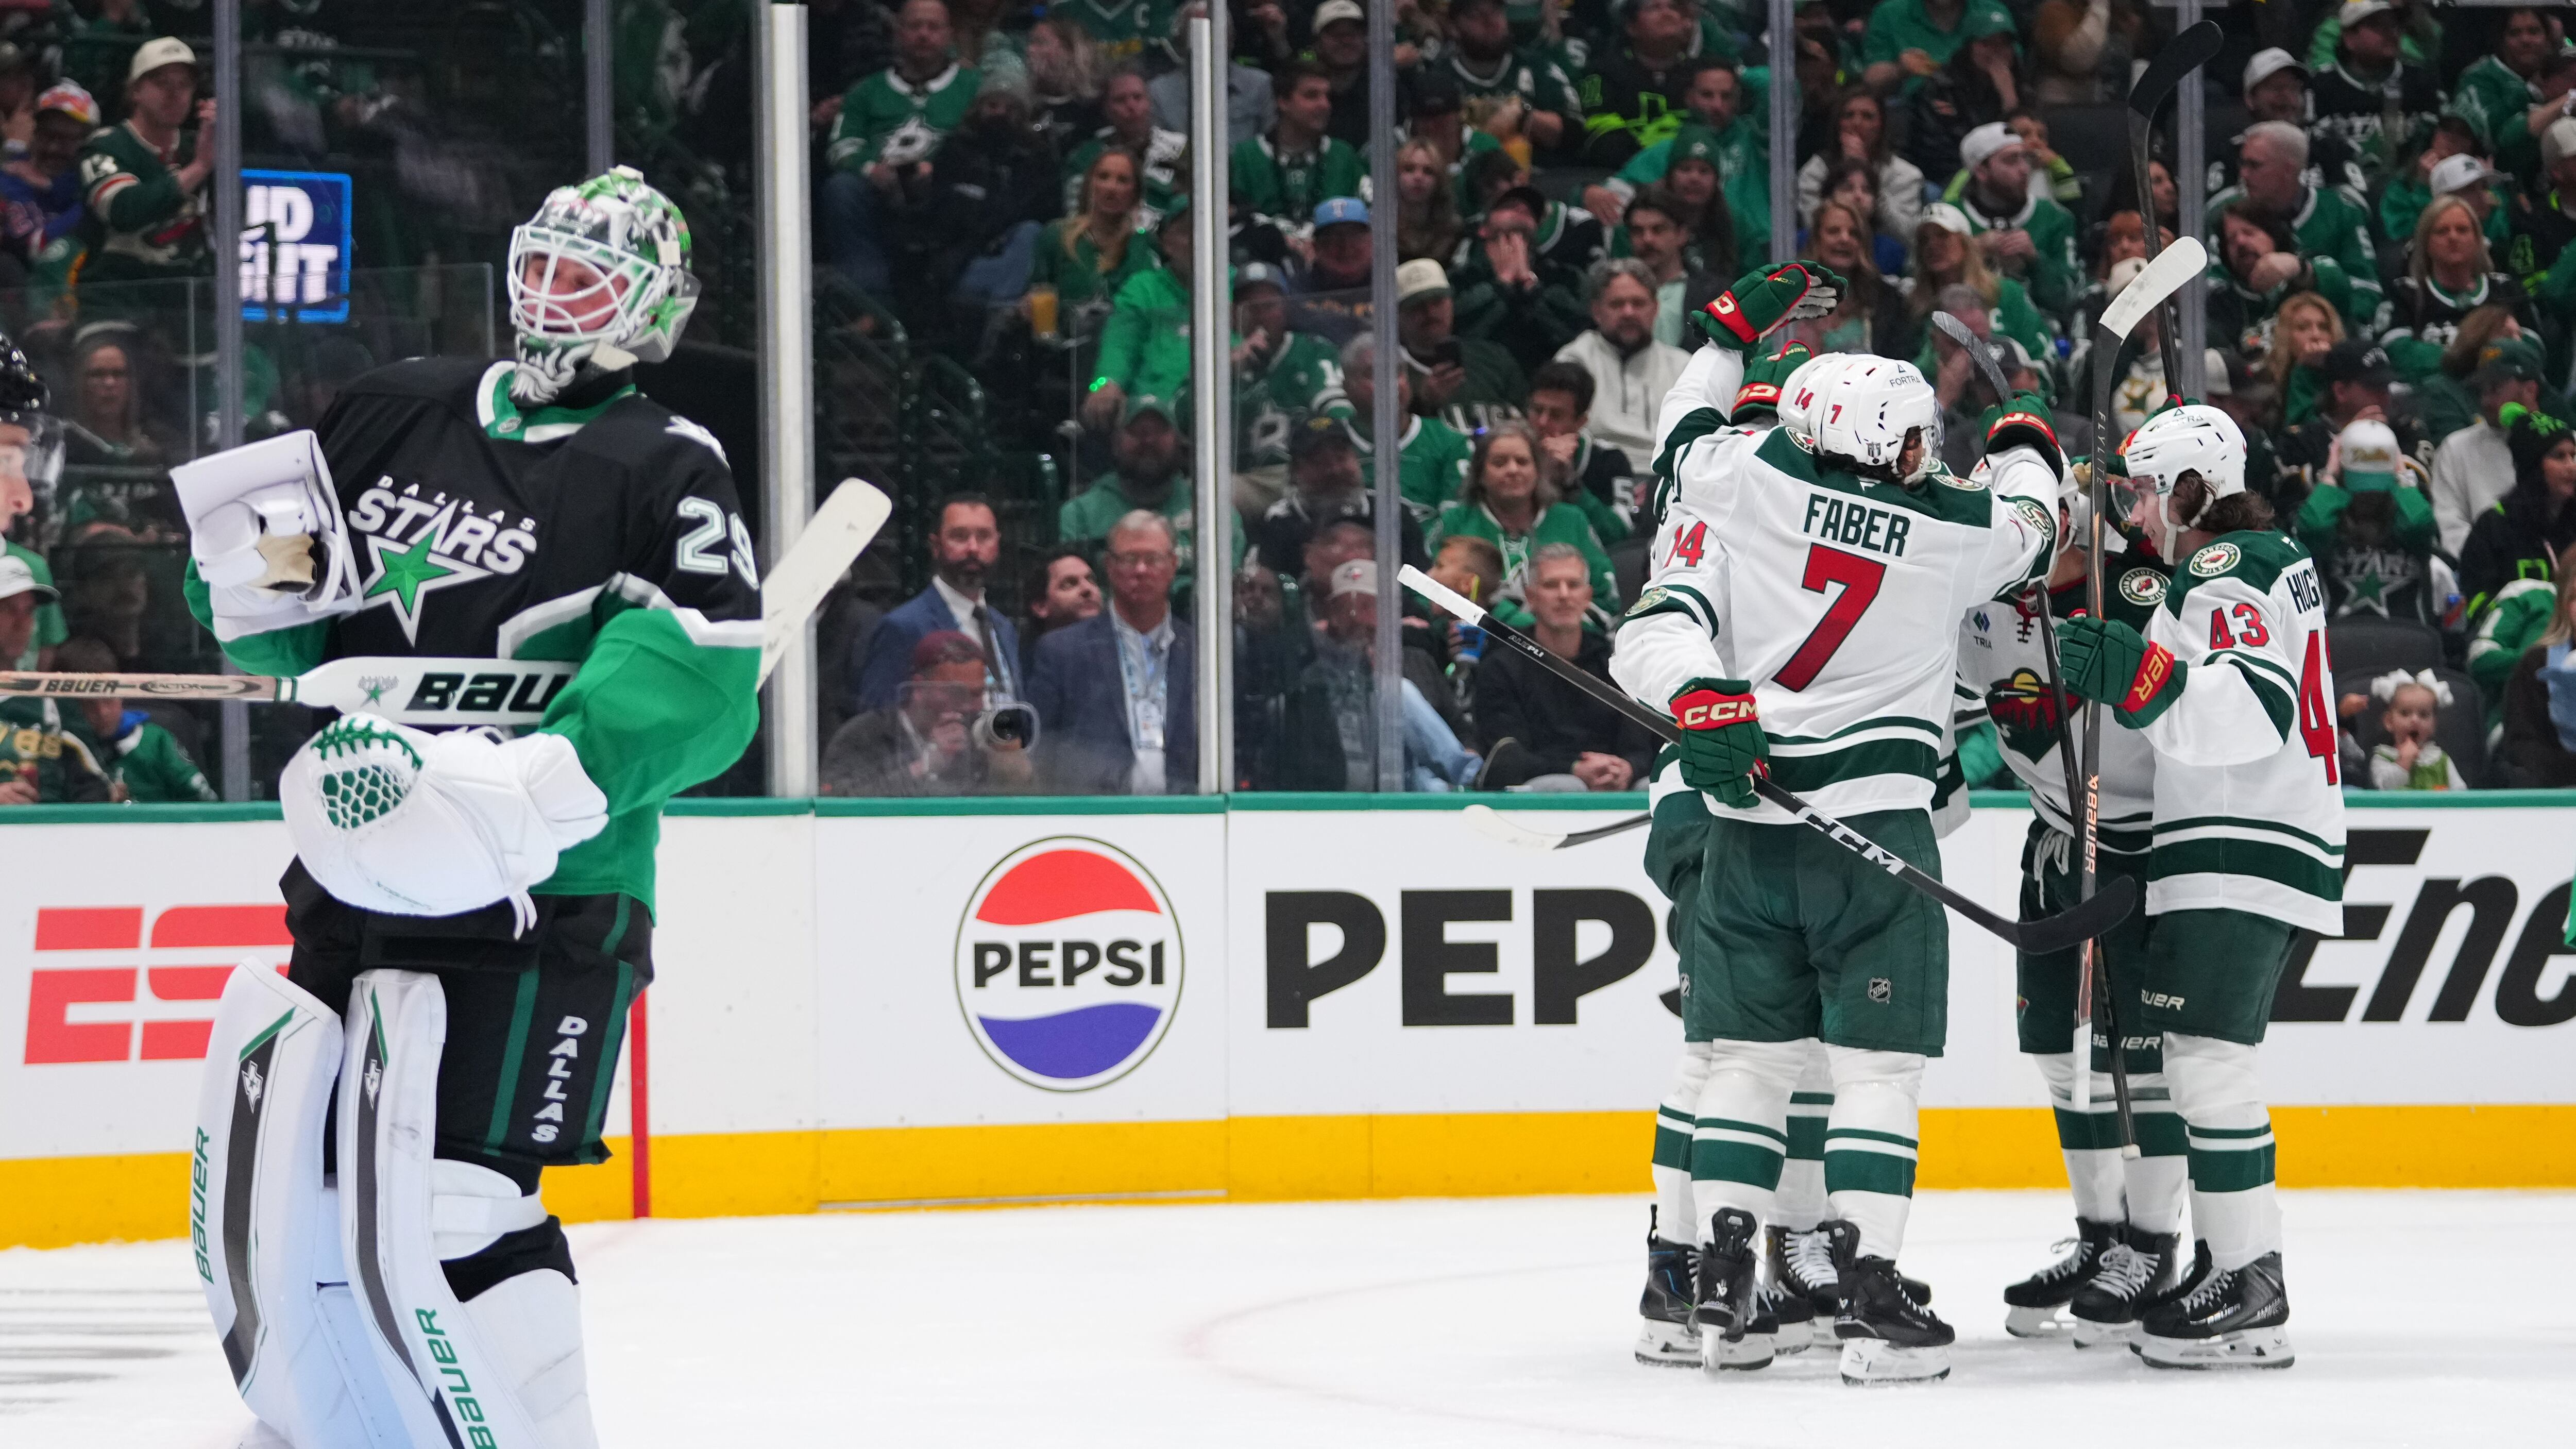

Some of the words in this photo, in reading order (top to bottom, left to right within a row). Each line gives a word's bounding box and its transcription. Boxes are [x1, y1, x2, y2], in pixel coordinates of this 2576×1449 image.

[1794, 387, 1814, 410] 14
[1890, 376, 1921, 387] FORTRA
[1831, 404, 1842, 424] 7
[2096, 410, 2107, 486] FLYLITE
[348, 487, 537, 575] STARS
[377, 475, 536, 532] DALLAS
[1804, 493, 1911, 557] FABER
[676, 495, 760, 591] 29
[1663, 520, 1708, 567] 14
[2200, 565, 2224, 574] WILD
[1770, 542, 1888, 693] 7
[1973, 635, 1993, 650] TRIA
[2210, 603, 2270, 650] 43
[44, 679, 118, 694] BAUER
[404, 672, 572, 713] BAU
[2134, 643, 2172, 701] UER
[1684, 701, 1759, 727] CCM
[2299, 626, 2336, 786] 4
[1796, 806, 1906, 876] CCM
[2086, 791, 2098, 874] BAUER
[24, 903, 297, 1064] ES
[974, 939, 1166, 989] PEPSI
[1265, 887, 1683, 1030] PEP
[531, 1015, 588, 1142] DALLAS
[193, 1126, 214, 1285] BAUER
[415, 1308, 498, 1449] BAUER
